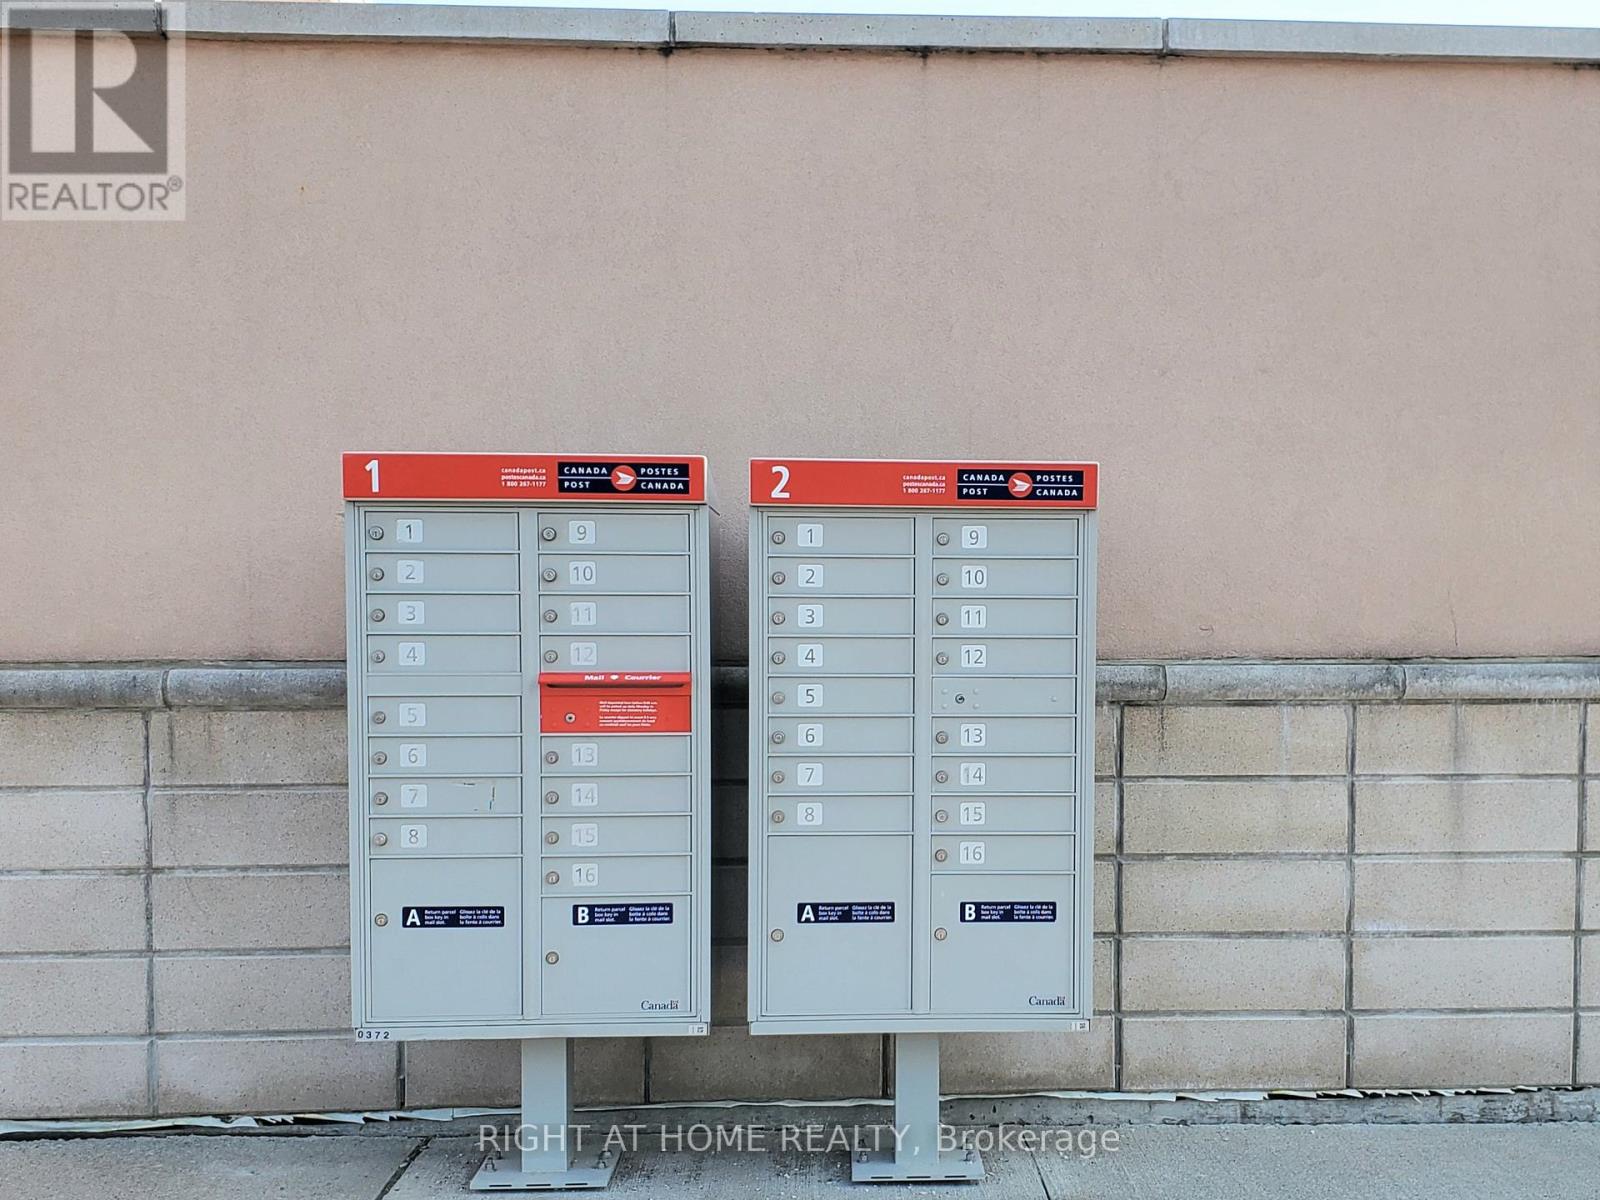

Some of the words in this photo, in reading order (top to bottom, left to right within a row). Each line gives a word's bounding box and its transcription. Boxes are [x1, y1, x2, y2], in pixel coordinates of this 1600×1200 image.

[364, 460, 379, 492] 1
[771, 466, 790, 498] 2
[406, 524, 412, 539] 1
[577, 526, 586, 540] 9
[807, 529, 813, 543] 1
[969, 530, 978, 545] 9
[406, 564, 415, 580] 2
[573, 566, 593, 581] 10
[805, 569, 815, 584] 2
[965, 570, 984, 585] 10
[406, 606, 415, 621] 3
[573, 607, 592, 622] 11
[806, 609, 814, 624] 3
[965, 610, 982, 624] 11
[406, 647, 417, 662] 4
[574, 647, 594, 662] 12
[805, 648, 815, 663] 4
[965, 649, 983, 664] 12
[806, 689, 814, 703] 5
[407, 708, 416, 723] 5
[805, 728, 815, 743] 6
[964, 728, 982, 743] 13
[408, 748, 417, 763] 6
[575, 747, 594, 762] 13
[805, 768, 814, 782] 7
[964, 767, 983, 782] 14
[408, 789, 417, 804] 7
[575, 788, 595, 803] 14
[805, 807, 814, 821] 8
[963, 807, 982, 821] 15
[408, 829, 418, 845] 8
[576, 828, 595, 842] 15
[963, 846, 982, 861] 16
[576, 868, 595, 883] 16
[406, 909, 420, 926] A
[578, 907, 589, 923] B
[801, 905, 815, 922] A
[965, 904, 975, 920] B
[641, 1000, 679, 1010] Canada
[1029, 996, 1065, 1006] Canada
[357, 1031, 390, 1040] 0372
